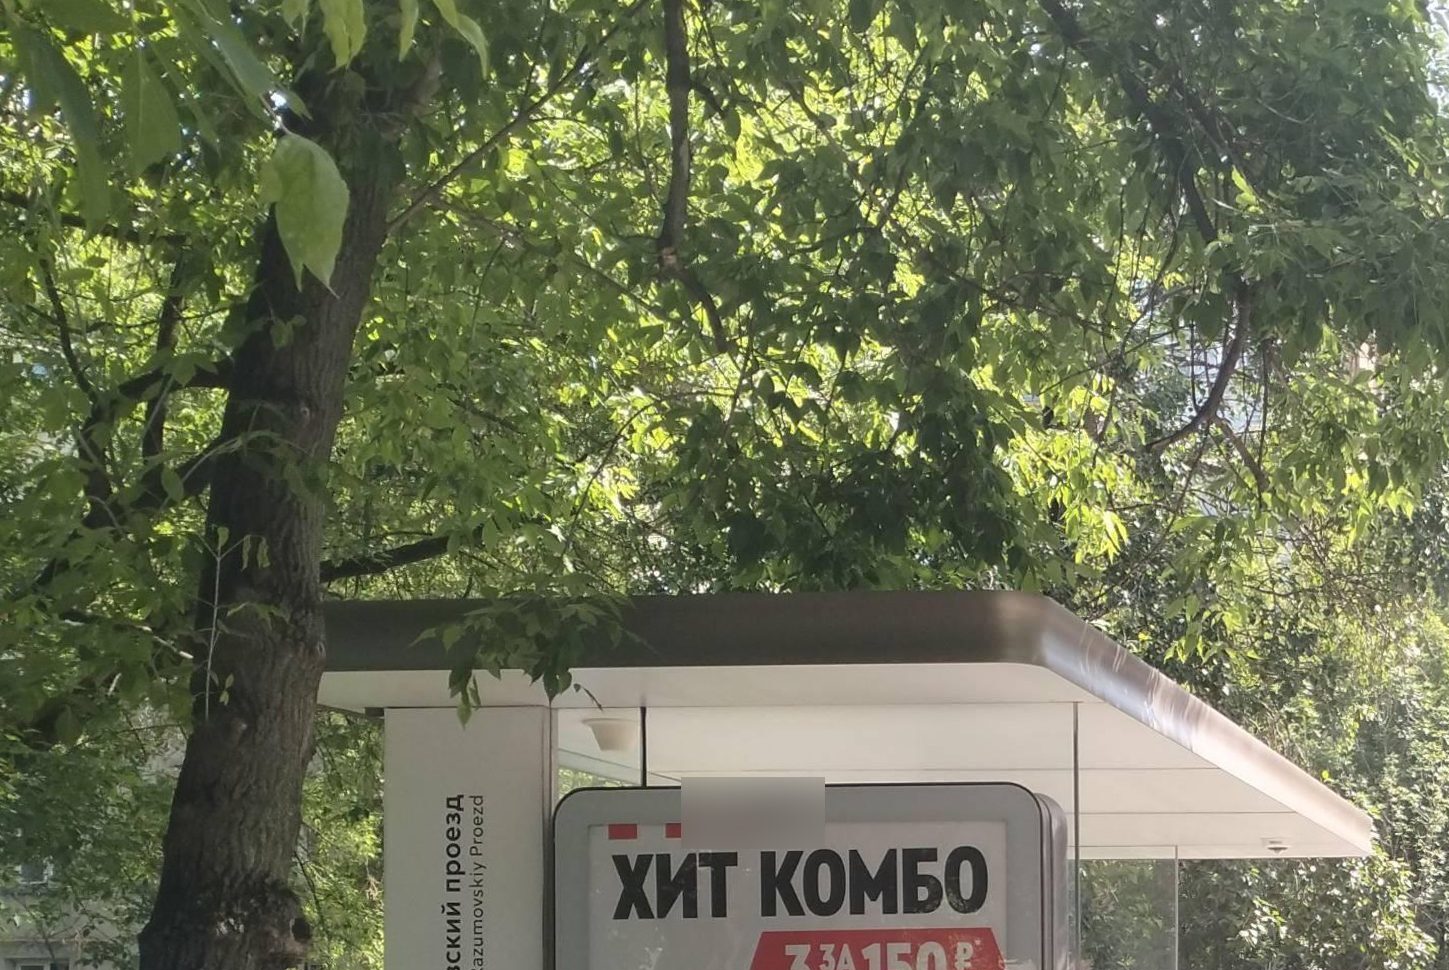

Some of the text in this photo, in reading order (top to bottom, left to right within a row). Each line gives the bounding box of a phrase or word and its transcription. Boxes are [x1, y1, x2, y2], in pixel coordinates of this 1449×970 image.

[445, 794, 464, 893] проезд
[470, 795, 484, 857] Proezd
[611, 845, 989, 920] ХИТ КОМБО
